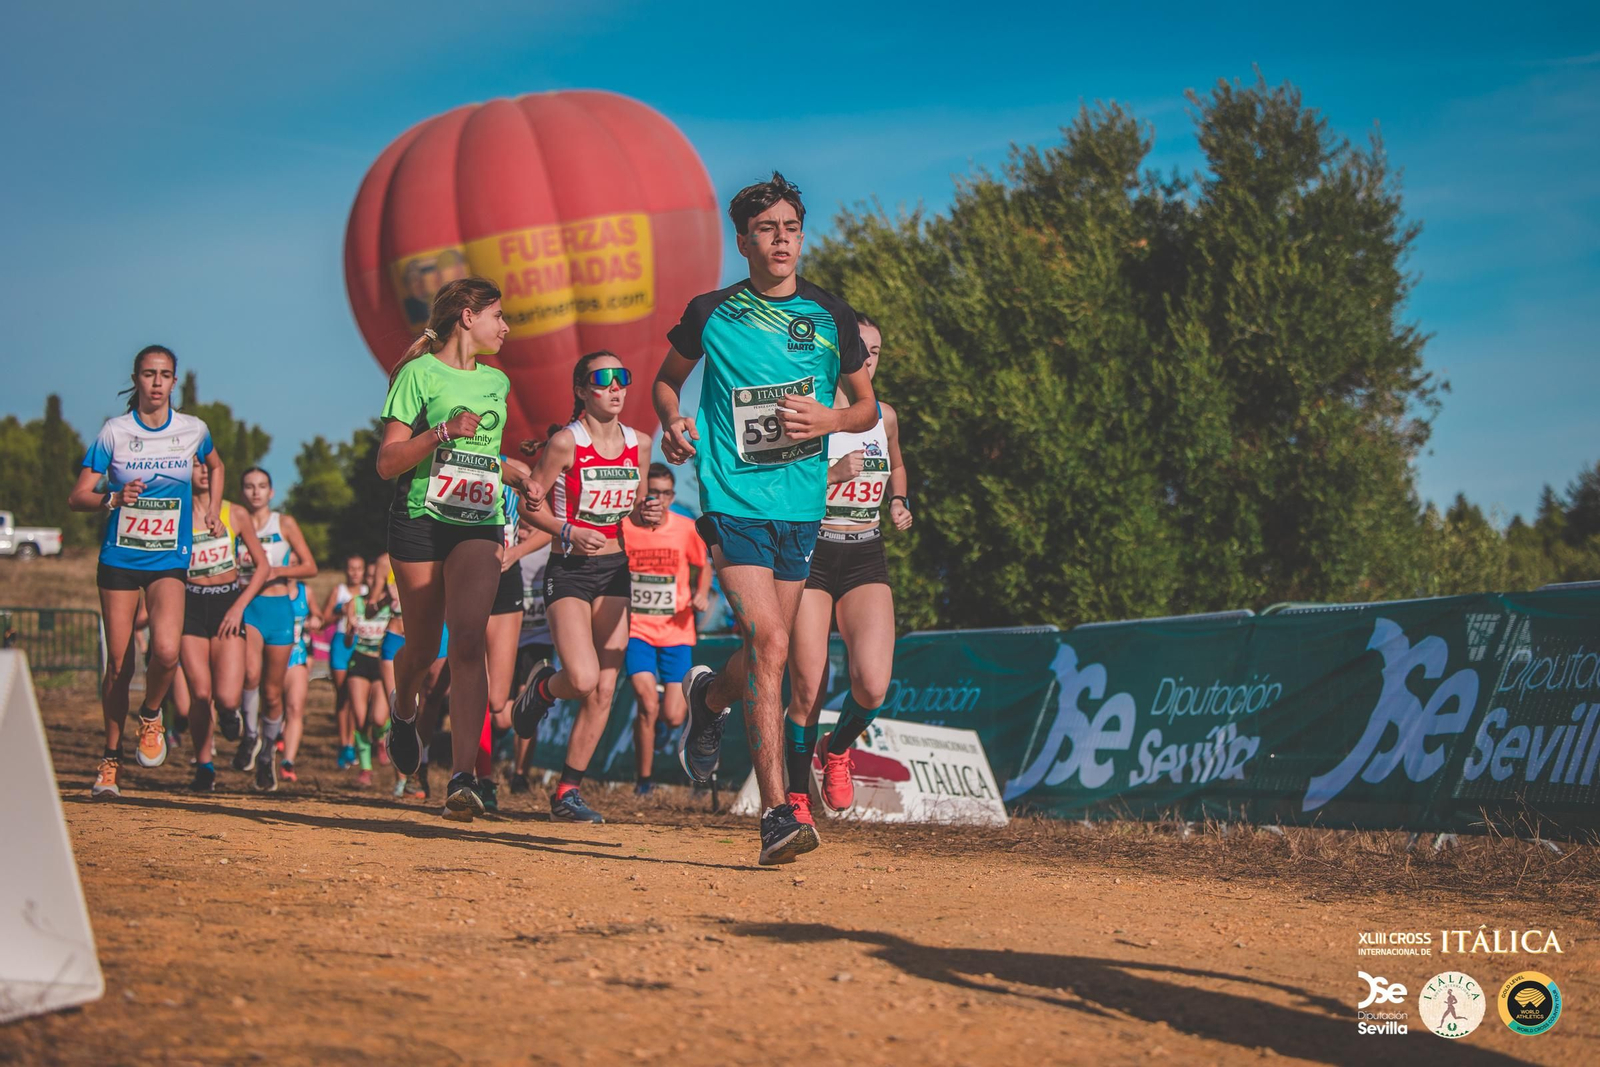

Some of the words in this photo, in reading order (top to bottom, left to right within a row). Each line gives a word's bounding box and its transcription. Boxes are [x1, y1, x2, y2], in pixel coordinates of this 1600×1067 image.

[500, 218, 638, 266] FUERZAS
[505, 251, 643, 301] ARMADAS
[125, 460, 188, 470] MARACENA
[456, 453, 488, 466] ITÁLICA
[437, 474, 494, 505] 7463
[589, 490, 635, 509] 7415
[828, 482, 883, 502] 7439
[125, 515, 175, 536] 7424
[824, 531, 846, 540] PUMA
[202, 585, 231, 595] PRO
[632, 589, 673, 605] 5973
[1150, 674, 1282, 724] Diputación
[1129, 722, 1261, 787] Sevilla
[909, 751, 994, 800] ITÁLICA
